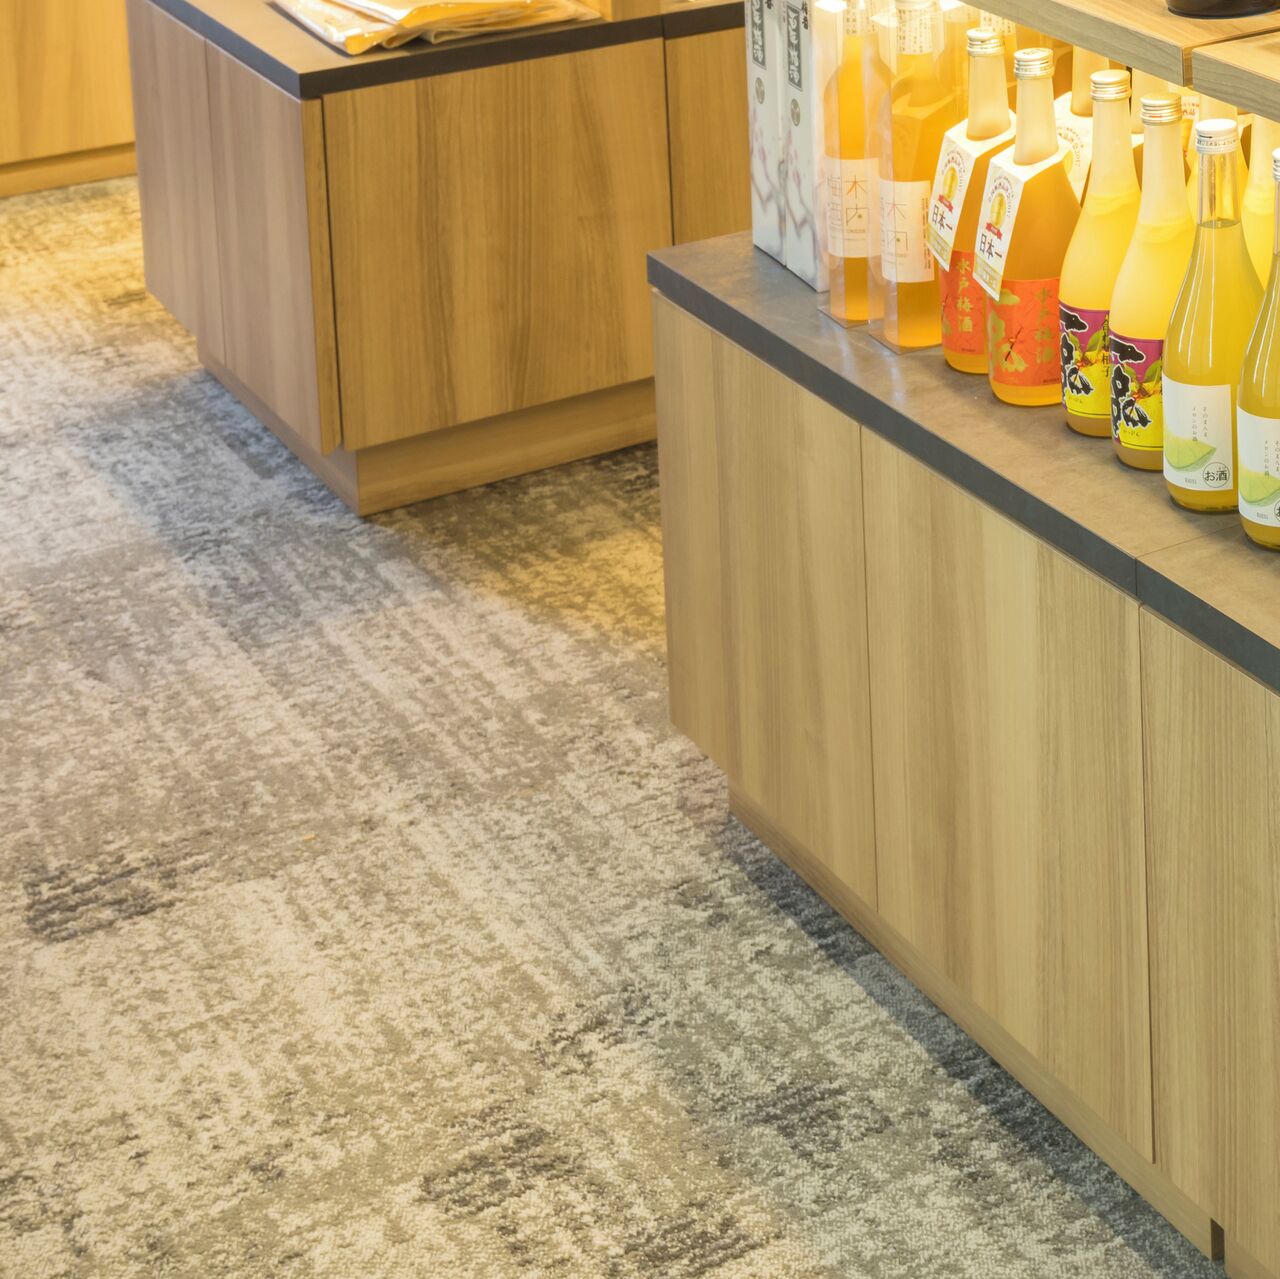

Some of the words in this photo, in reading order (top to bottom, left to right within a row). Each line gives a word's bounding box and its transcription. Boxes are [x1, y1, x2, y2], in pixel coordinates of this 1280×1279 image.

[931, 204, 953, 233] 日本一
[979, 232, 1003, 260] 日本一
[956, 258, 973, 333] 水戸梅酒
[1204, 467, 1228, 482] お酒
